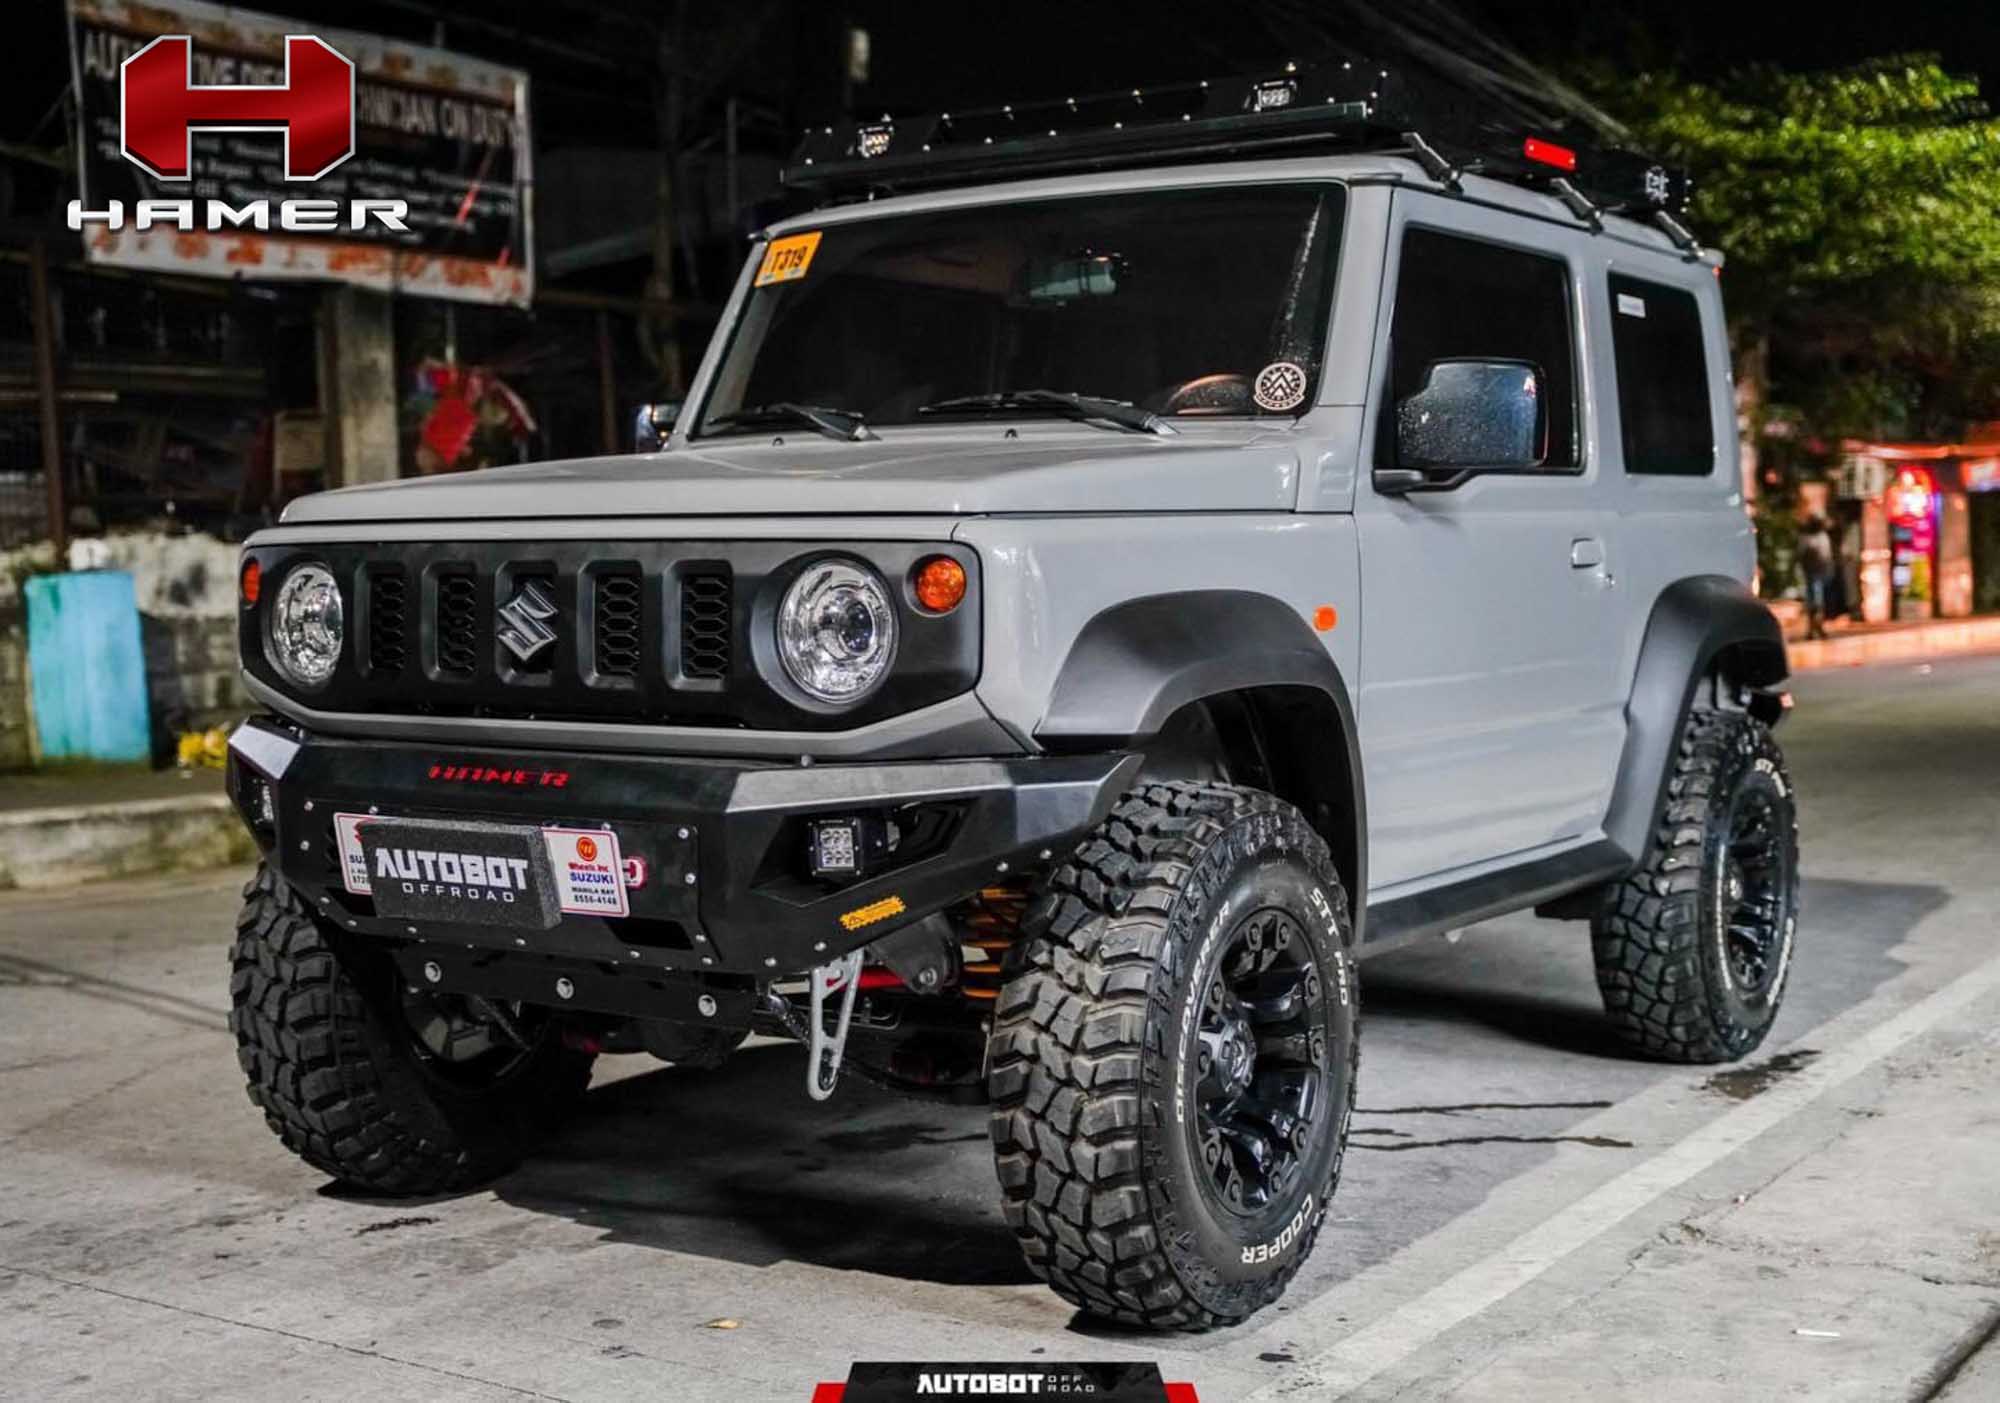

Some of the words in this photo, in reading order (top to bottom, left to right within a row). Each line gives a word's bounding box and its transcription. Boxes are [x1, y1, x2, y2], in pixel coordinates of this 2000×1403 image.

[428, 765, 570, 788] HAMER
[375, 847, 529, 890] AUTOBOT
[570, 873, 614, 884] SUZUKI
[401, 882, 515, 903] OFFROAD
[1309, 886, 1340, 937] STT
[1241, 1193, 1314, 1264] COOPER
